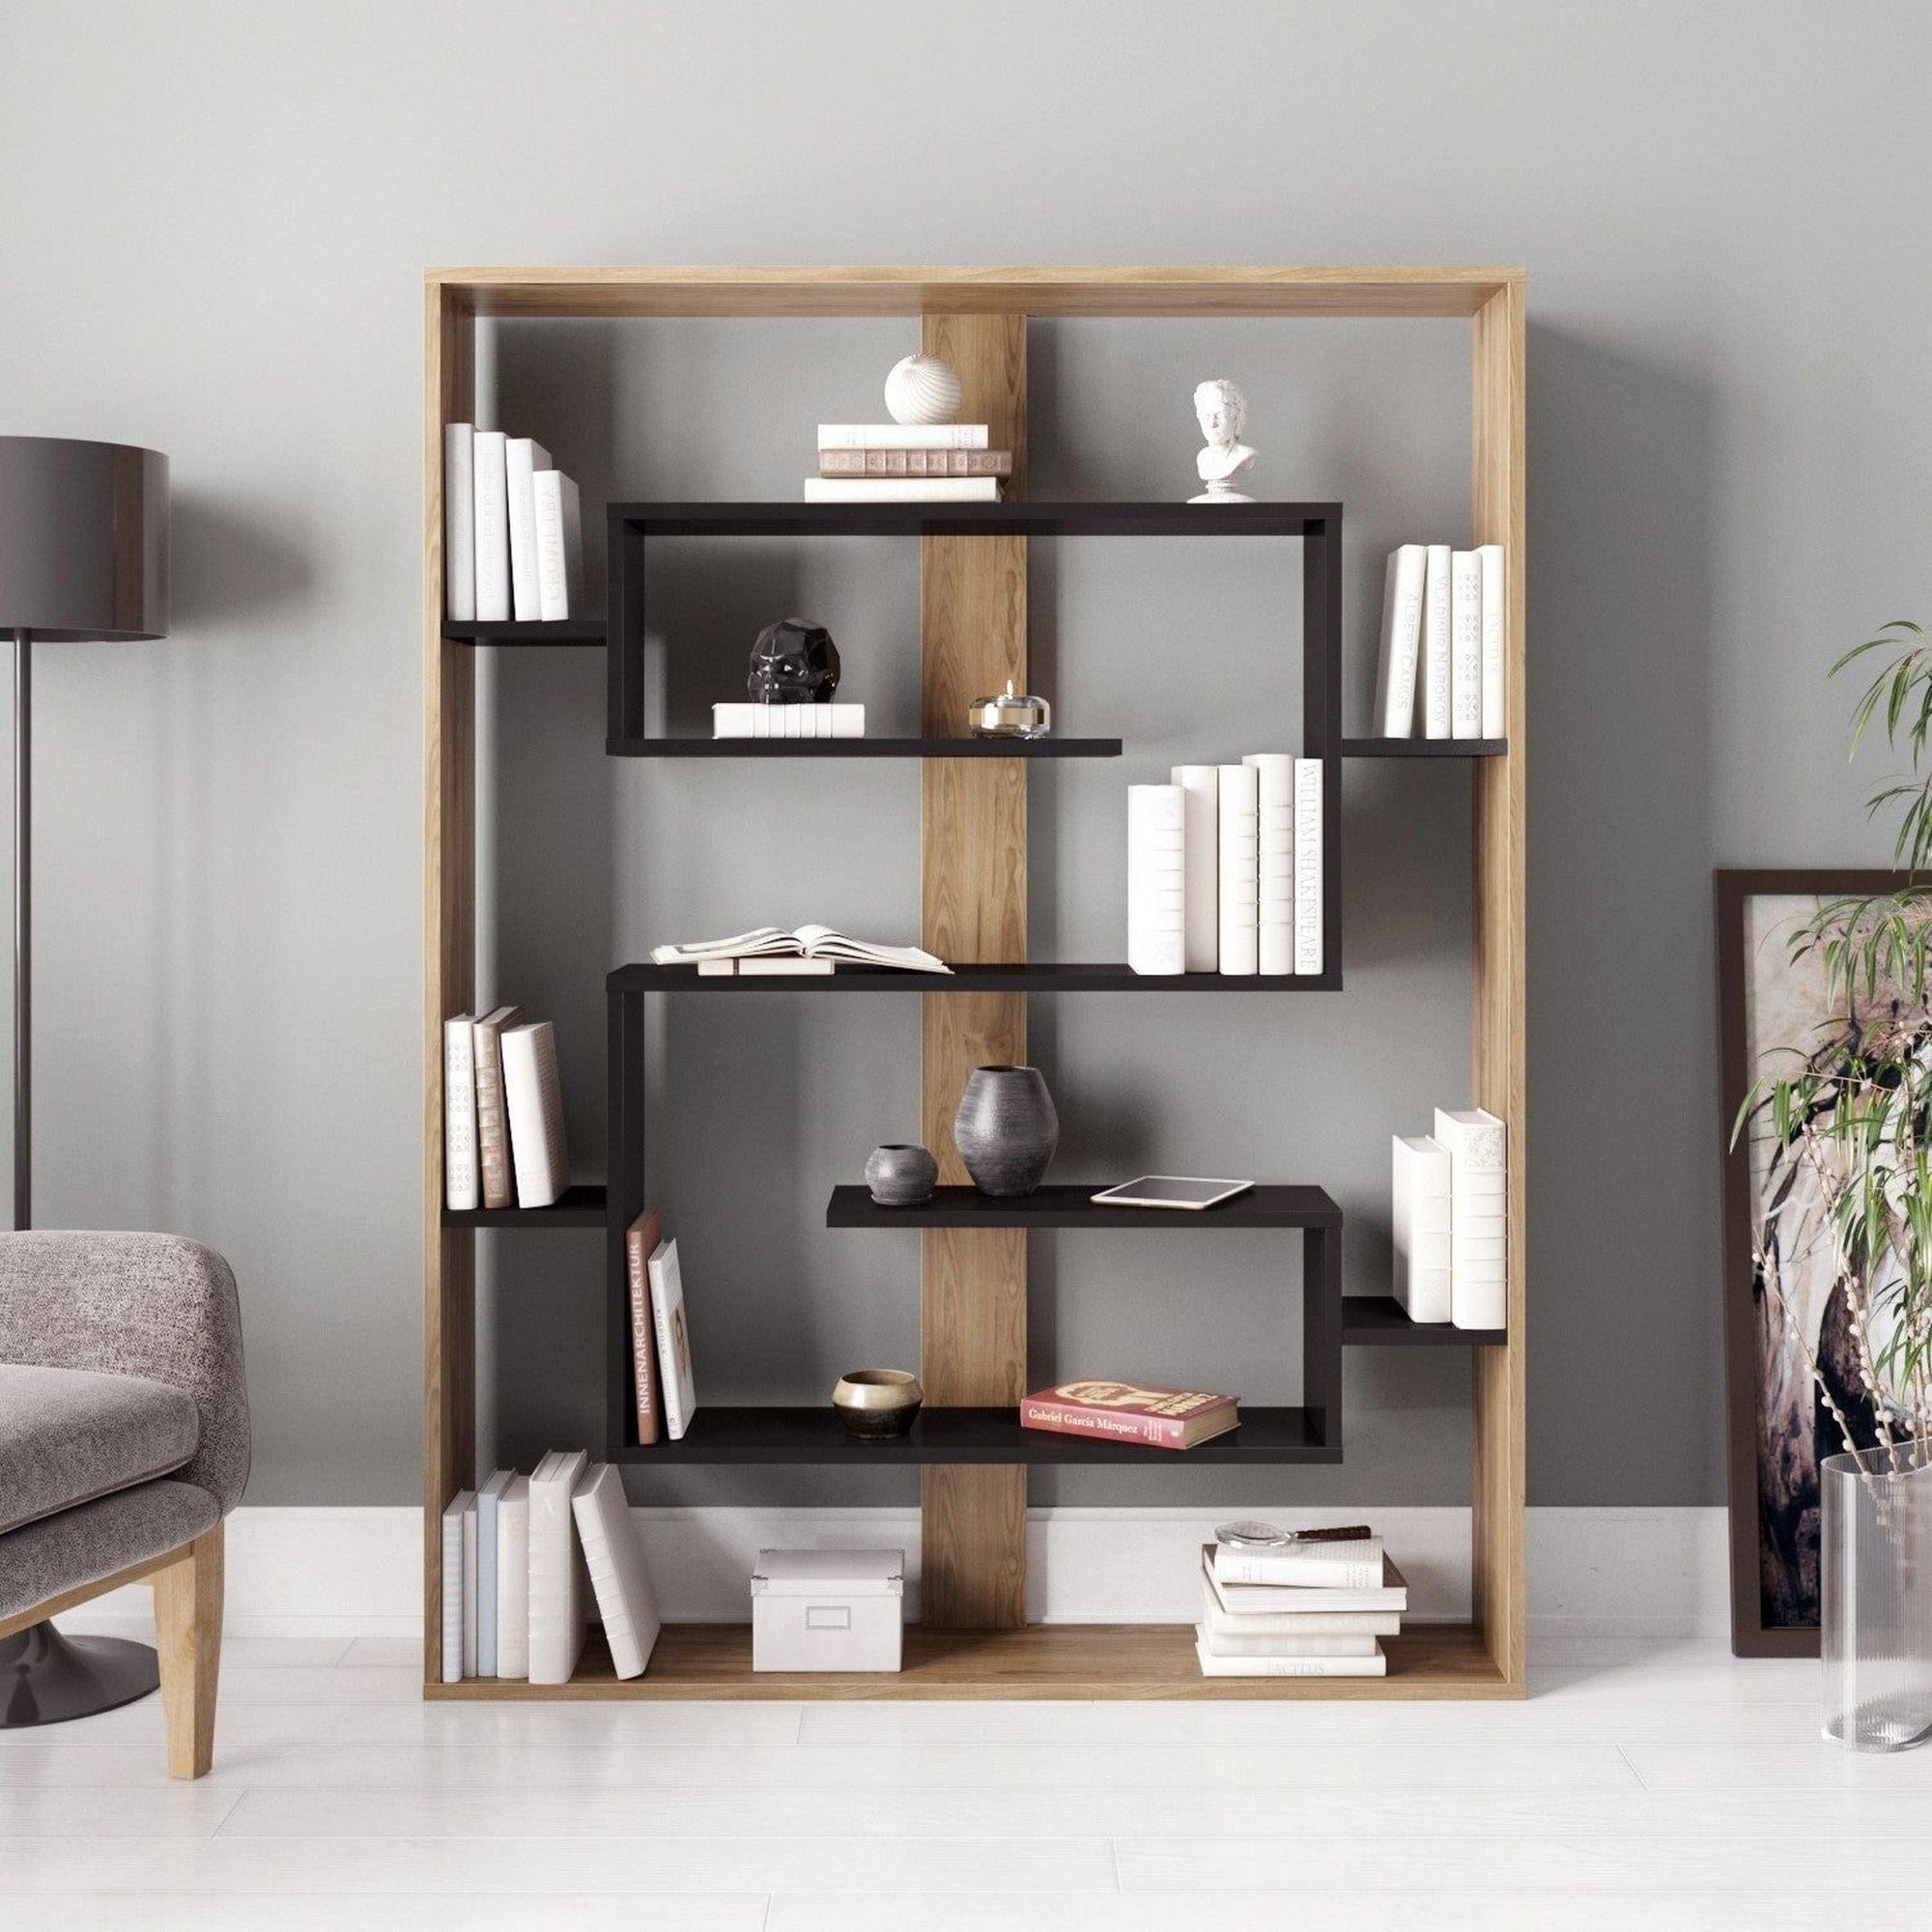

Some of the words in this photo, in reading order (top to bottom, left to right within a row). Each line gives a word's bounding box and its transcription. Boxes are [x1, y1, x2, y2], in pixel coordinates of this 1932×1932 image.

[1433, 577, 1448, 644] VLADIMIR
[1433, 647, 1448, 724] NABOKOV
[1300, 763, 1318, 842] WILLIAM
[1300, 849, 1318, 968] SHAKESPEARE
[627, 1243, 651, 1415] INNENARCHITEKTUR
[1028, 1407, 1063, 1424] Gabriel
[1065, 1413, 1094, 1429] García
[1096, 1416, 1139, 1435] Márquez
